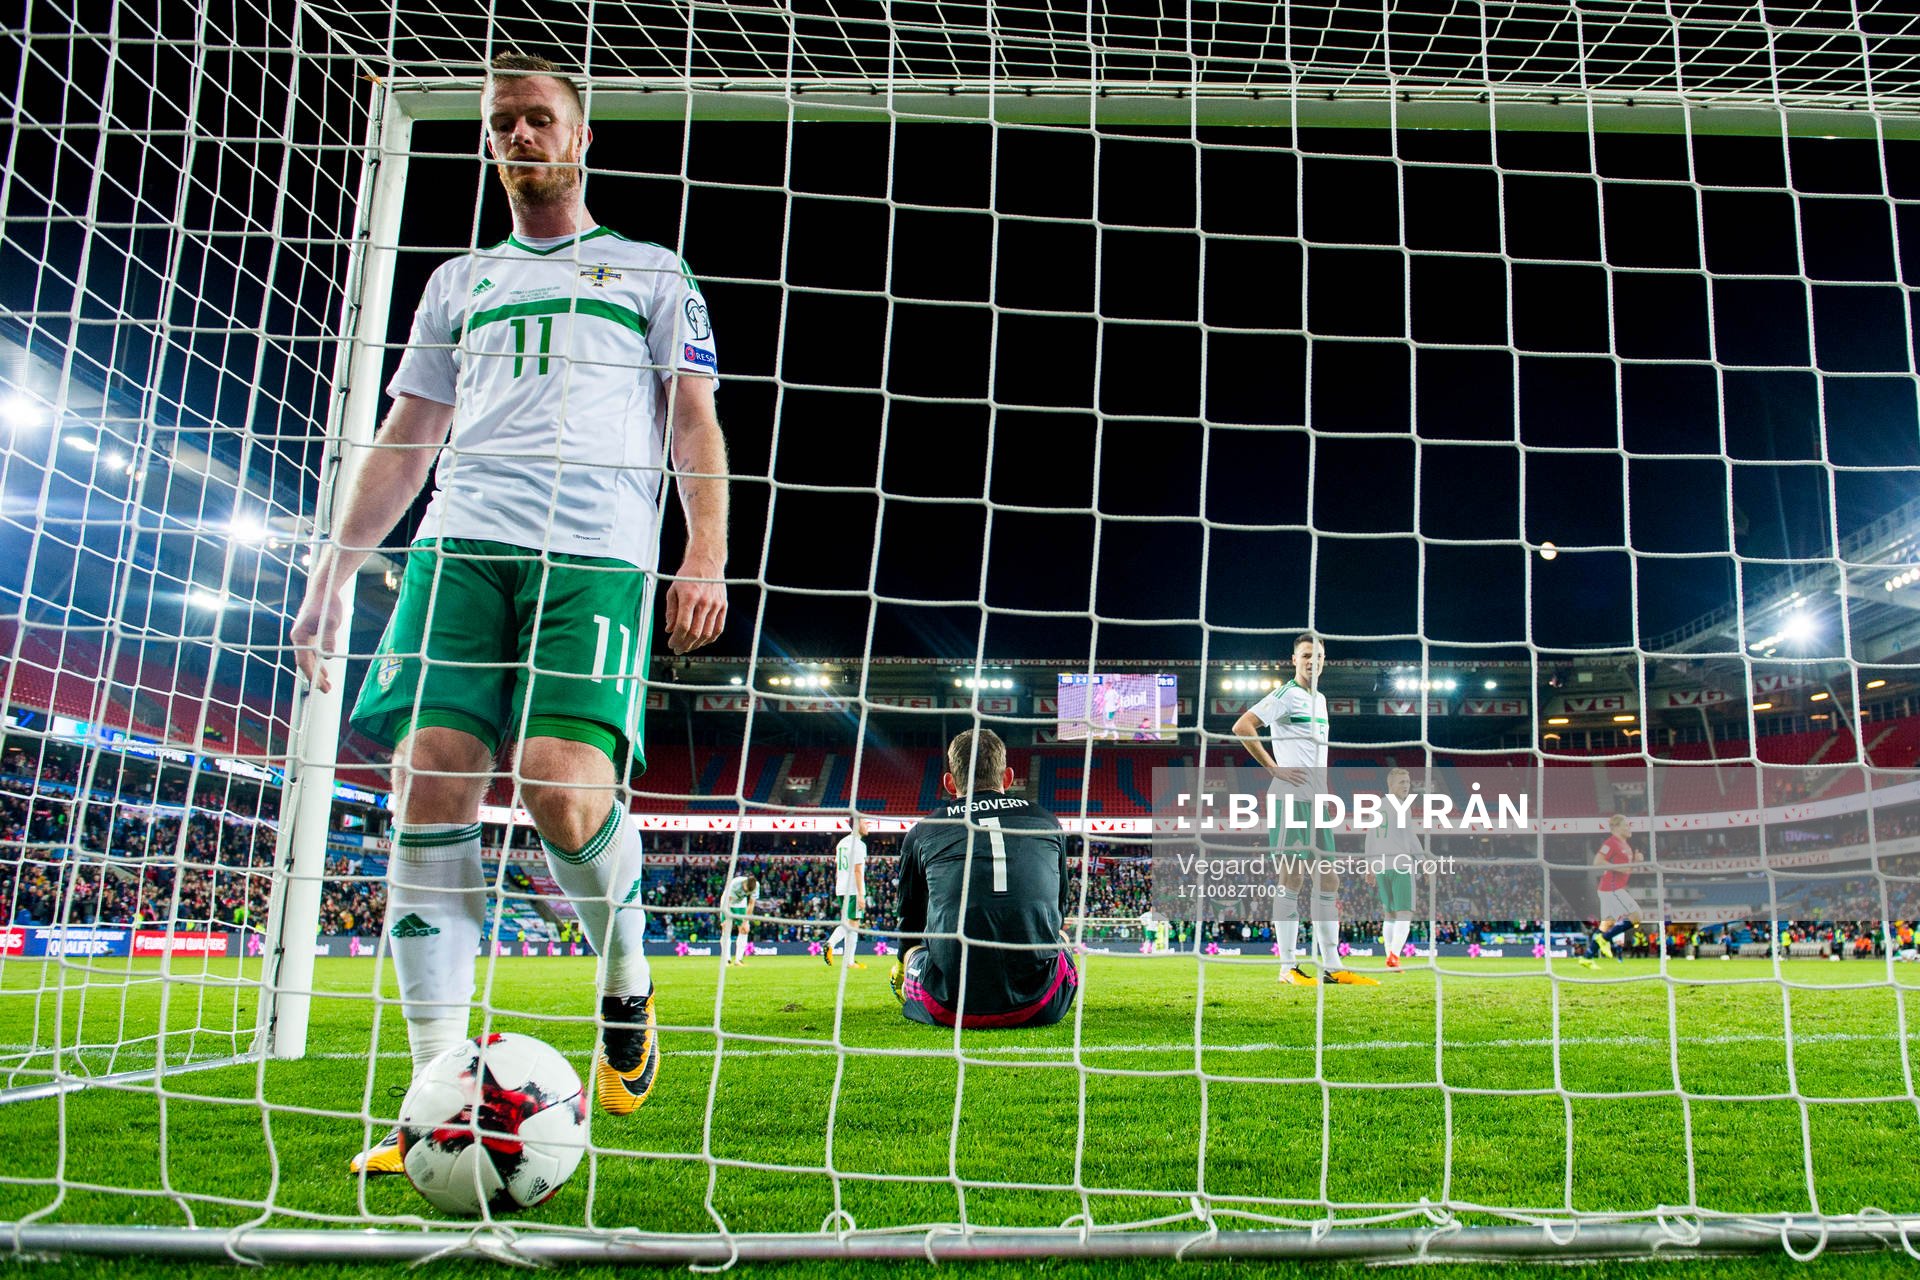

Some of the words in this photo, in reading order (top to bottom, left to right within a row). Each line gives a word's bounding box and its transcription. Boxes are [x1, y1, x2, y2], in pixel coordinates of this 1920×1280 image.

[510, 316, 552, 378] 11
[591, 614, 630, 694] 11
[1565, 696, 1624, 712] VG
[1669, 690, 1725, 706] VG
[1384, 700, 1441, 714] VG
[1463, 700, 1522, 714] VG
[947, 798, 1029, 816] McGOVERN
[645, 855, 676, 863] VG
[979, 817, 1007, 892] 1
[391, 926, 441, 938] adidas
